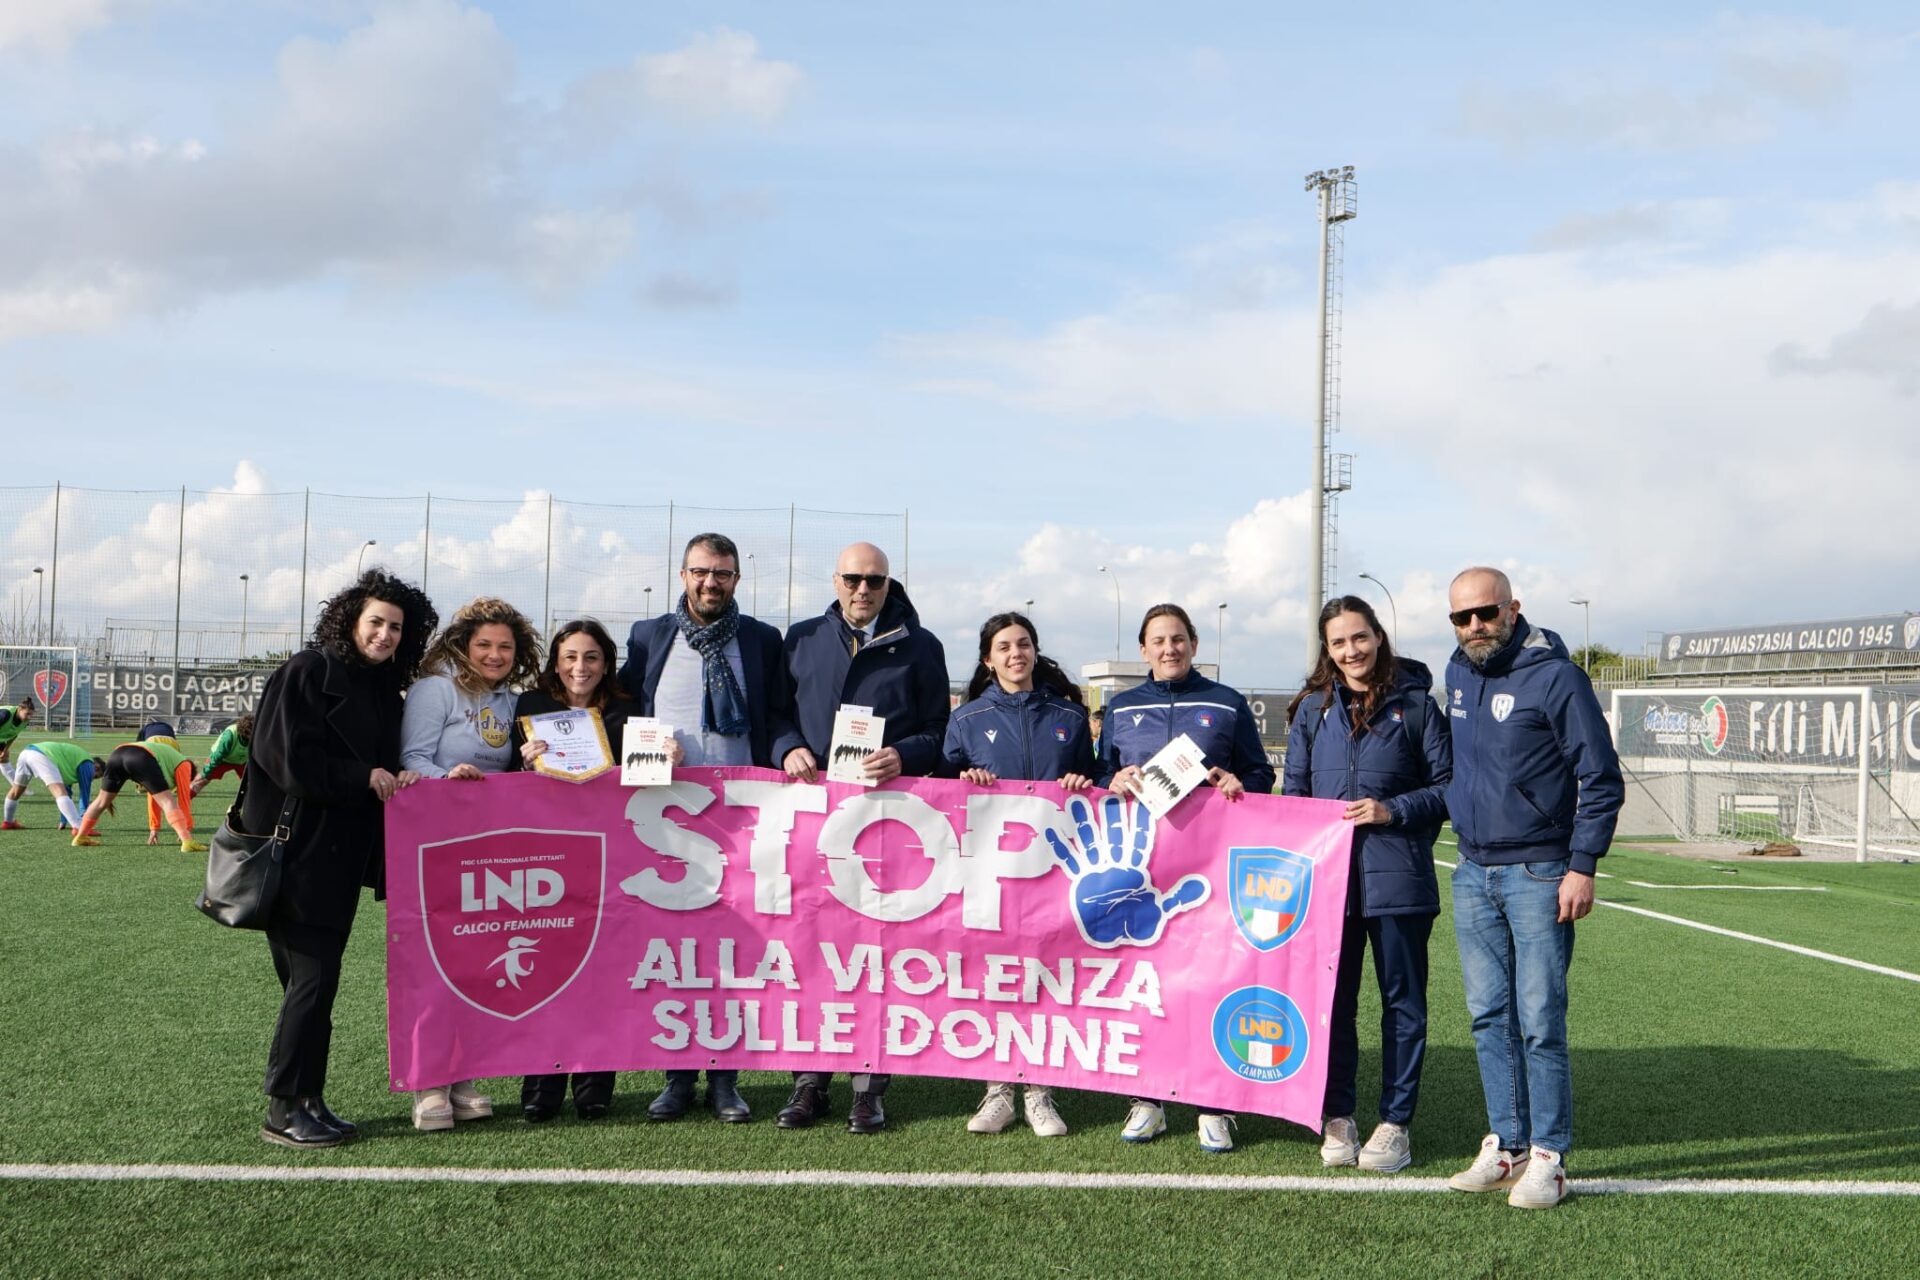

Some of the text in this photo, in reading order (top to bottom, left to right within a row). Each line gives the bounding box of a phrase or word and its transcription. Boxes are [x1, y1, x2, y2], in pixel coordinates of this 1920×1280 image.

[1685, 624, 1894, 656] SANT'ANASTASIA CALCIO 1945
[77, 672, 175, 691] PELUSO
[105, 693, 159, 710] 1980
[529, 854, 565, 862] DILETTANTI
[619, 780, 1064, 931] STOP
[461, 867, 565, 914] LND
[1246, 873, 1293, 902] LND
[453, 917, 575, 936] CALCIO FEMMINILE
[628, 938, 1165, 1018] ALLA VIOLENZA
[650, 1000, 1142, 1077] SULLE DONNE
[1239, 1015, 1284, 1040] LND
[1238, 1063, 1284, 1080] CAMPANIA
